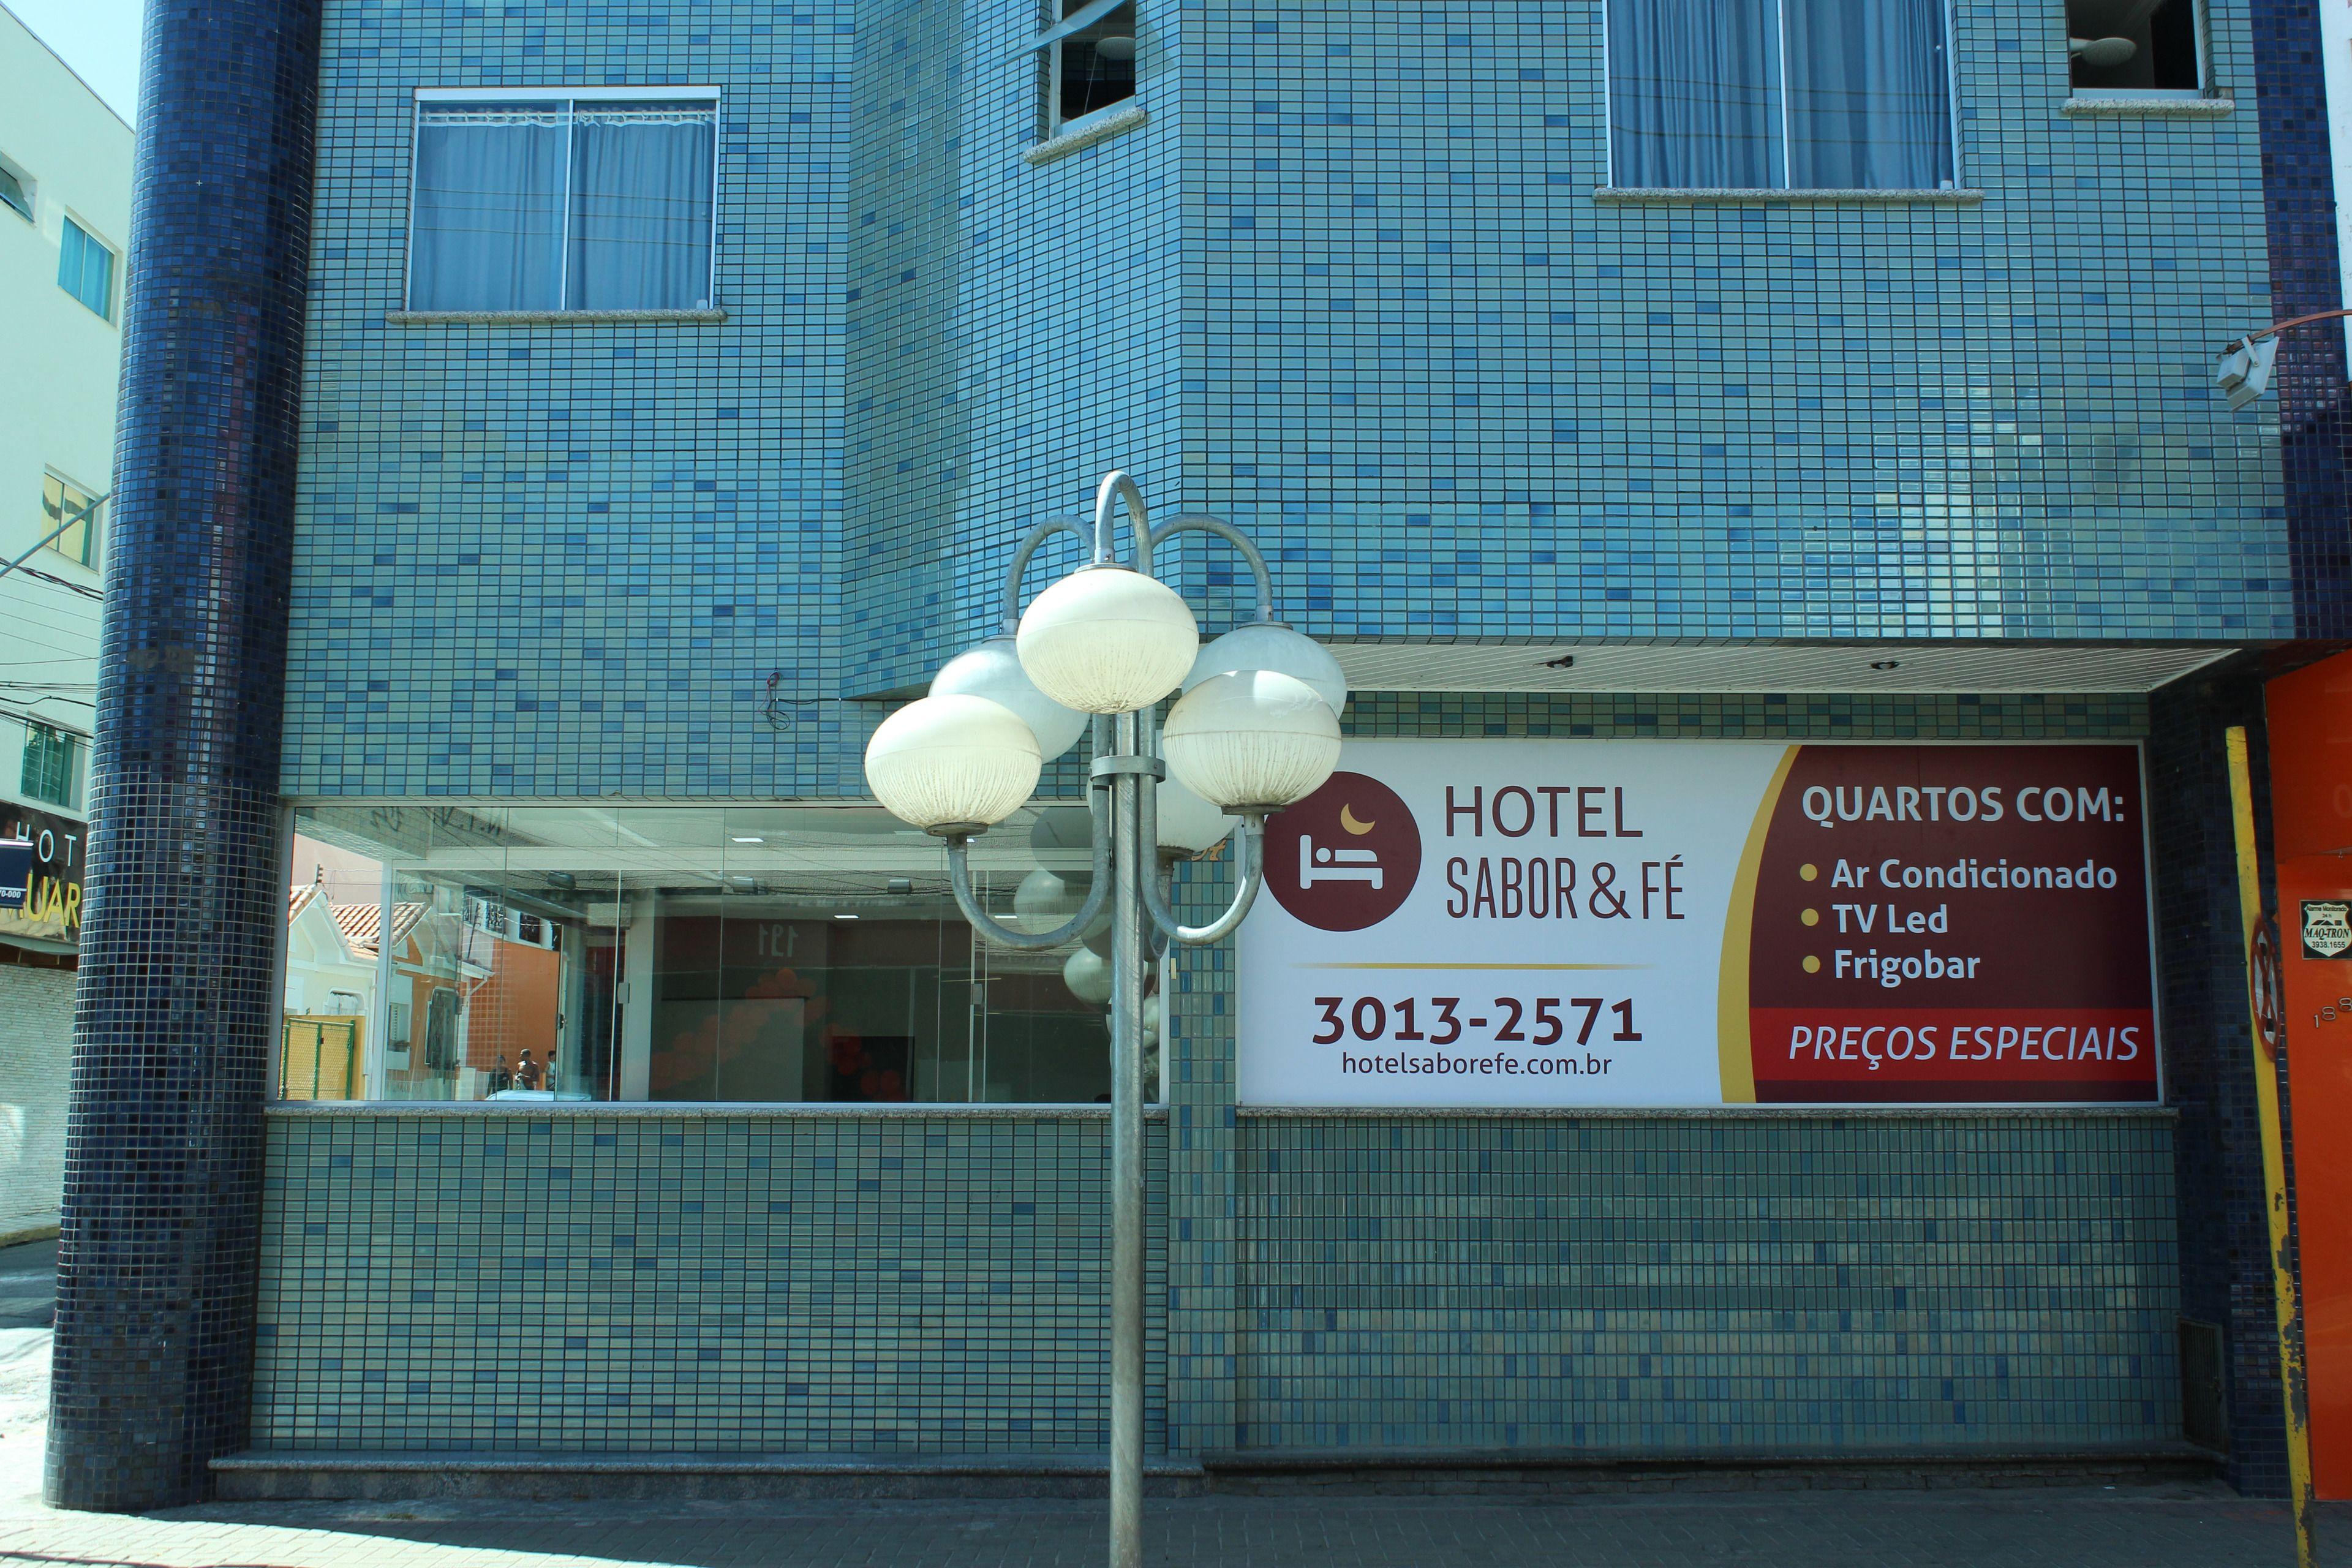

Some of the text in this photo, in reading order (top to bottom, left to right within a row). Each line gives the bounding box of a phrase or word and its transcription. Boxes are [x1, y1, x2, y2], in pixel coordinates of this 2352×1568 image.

[1446, 786, 1643, 837] HOTEL
[1802, 786, 2124, 828] QUARTOS COM:
[1447, 854, 1685, 919] SABOR & FÉ
[1831, 858, 2117, 889] Ar Condicionado
[0, 890, 21, 899] 0-000
[9, 873, 81, 929] UAR
[1832, 903, 1948, 933] TV Led
[2305, 928, 2350, 940] MAQ-TRON
[1835, 949, 1981, 987] Frigobar
[1312, 996, 1643, 1046] 3013-2571
[1343, 1052, 1612, 1075] hotelsaborefe.com.br
[1789, 1026, 2139, 1071] PREÇOS ESPECIAIS
